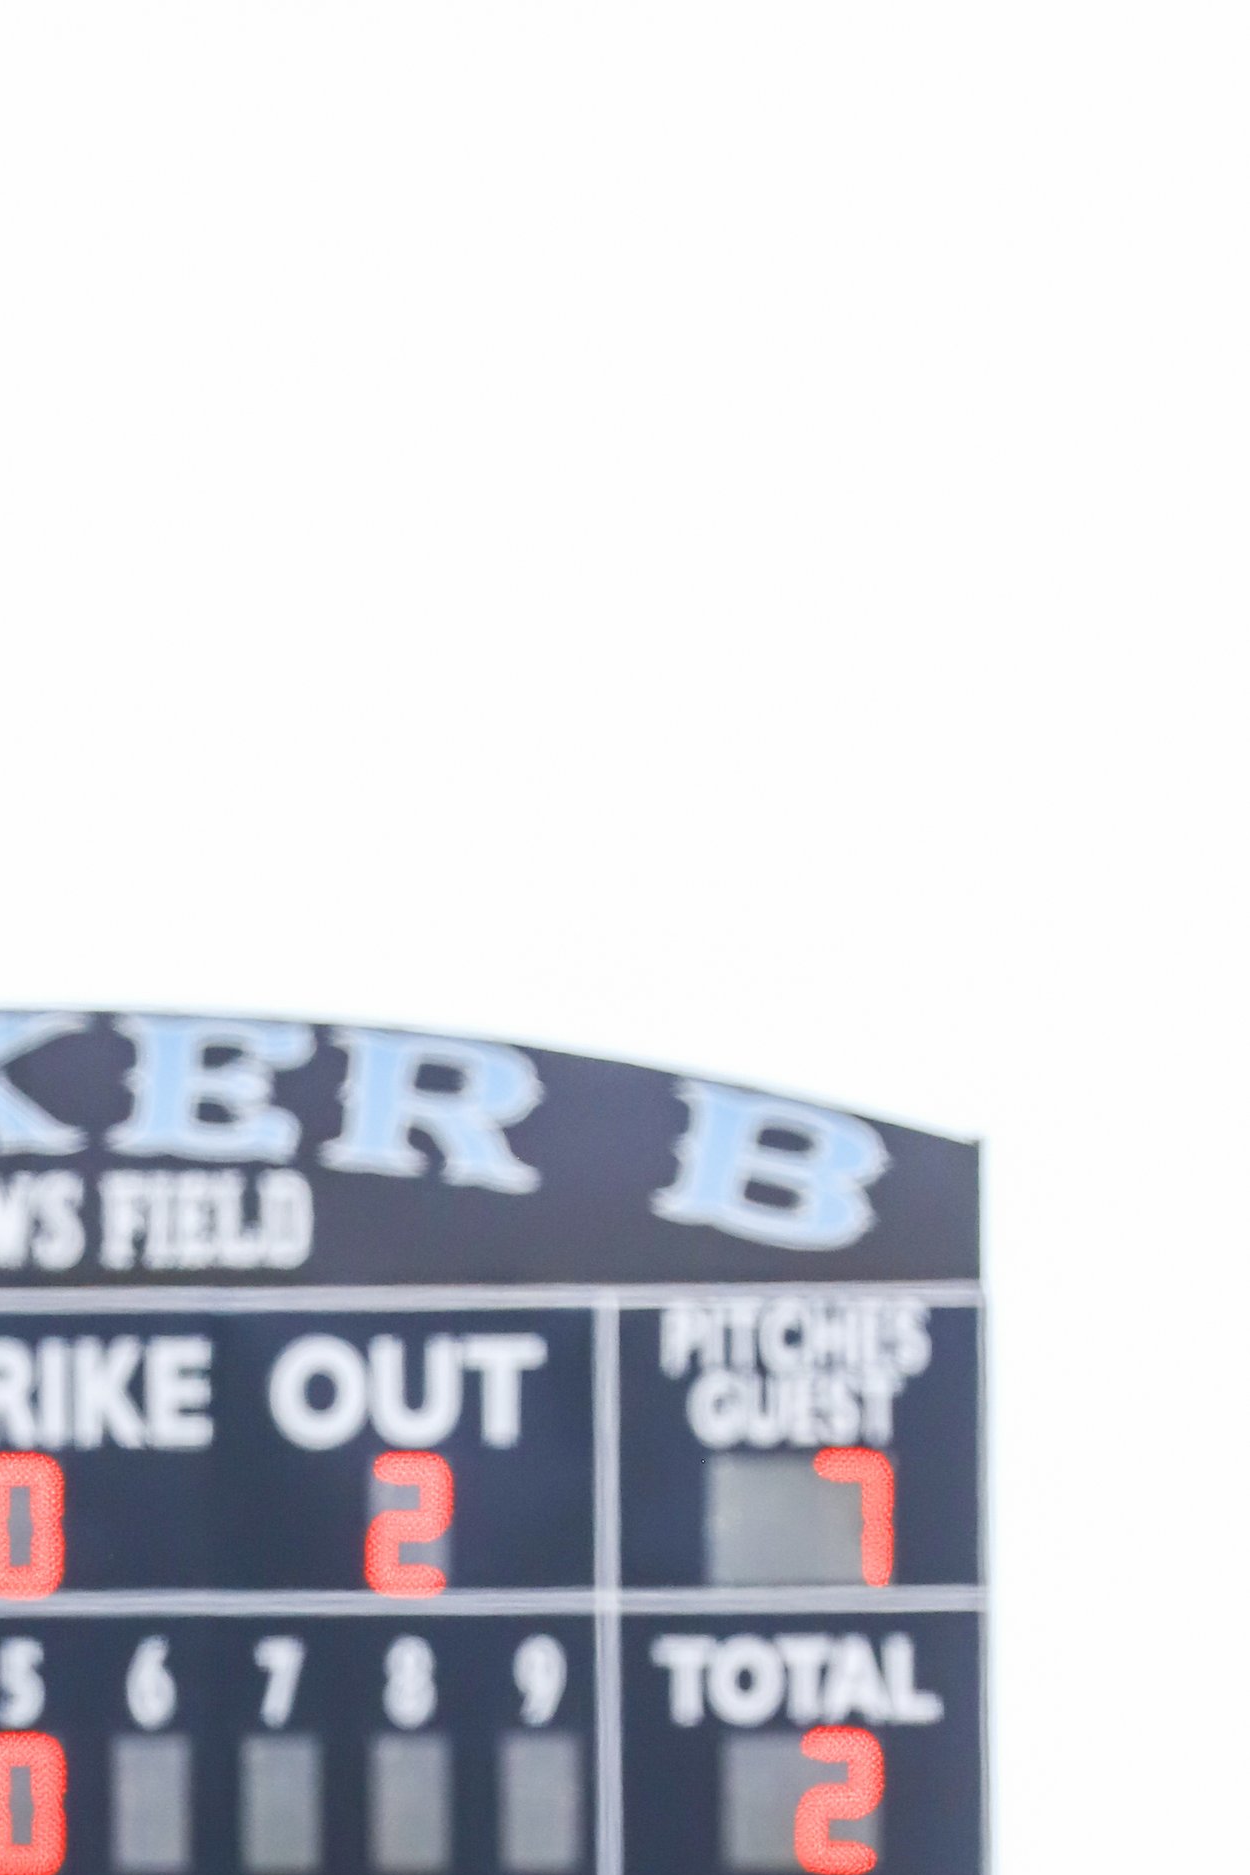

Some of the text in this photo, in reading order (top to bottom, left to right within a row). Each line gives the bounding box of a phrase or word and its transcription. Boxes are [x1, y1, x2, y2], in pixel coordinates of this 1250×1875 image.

[651, 1074, 889, 1251] B
[100, 1170, 314, 1270] FIELD
[659, 1297, 933, 1380] PITCHES
[268, 1333, 547, 1450] OUT
[687, 1372, 905, 1449] GUEST
[364, 1450, 454, 1598] 2
[812, 1446, 895, 1587] 7
[126, 1636, 177, 1728] 6
[254, 1636, 304, 1727] 7
[383, 1635, 437, 1727] 8
[513, 1635, 567, 1726] 9
[652, 1633, 944, 1726] TOTAL
